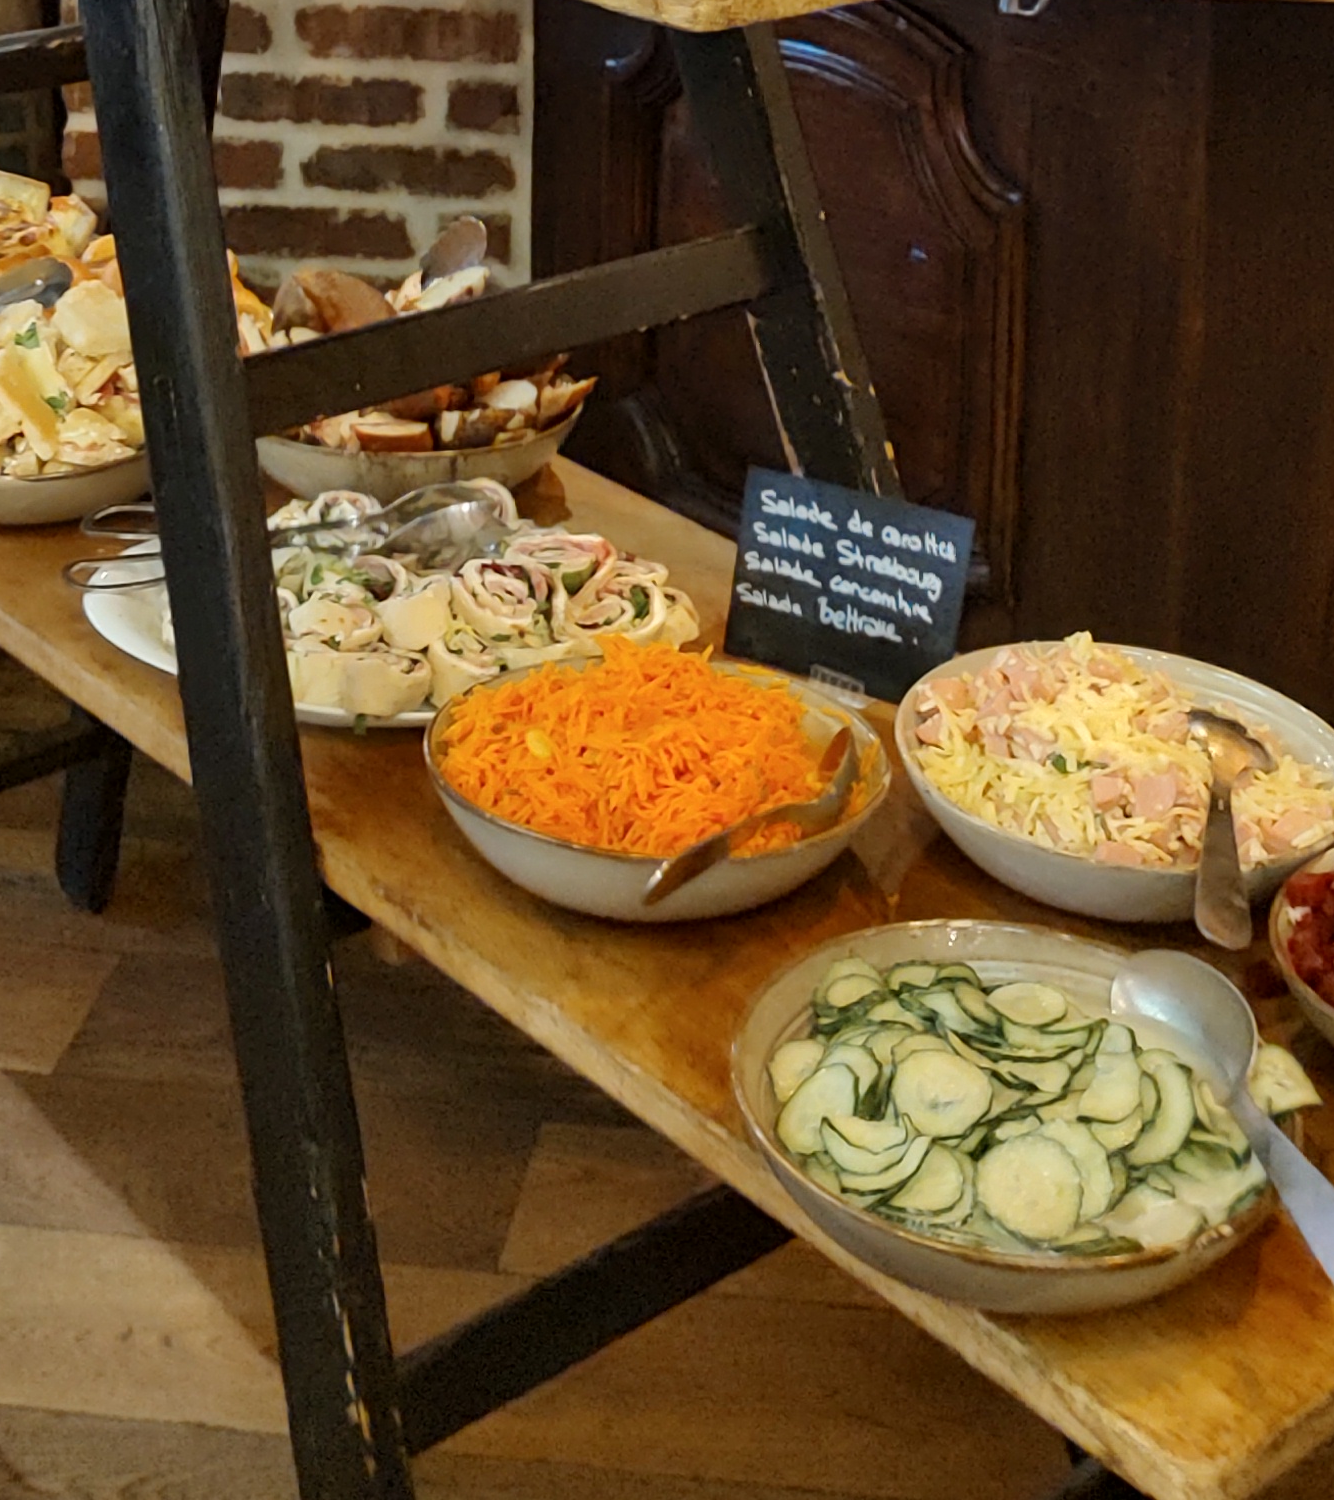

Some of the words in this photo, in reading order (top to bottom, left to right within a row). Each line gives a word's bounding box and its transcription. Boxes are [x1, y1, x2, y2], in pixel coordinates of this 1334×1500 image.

[761, 489, 838, 531] Salade
[847, 510, 874, 538] de
[753, 521, 826, 559] Salade
[744, 551, 822, 589] Salade
[736, 582, 803, 617] Salade
